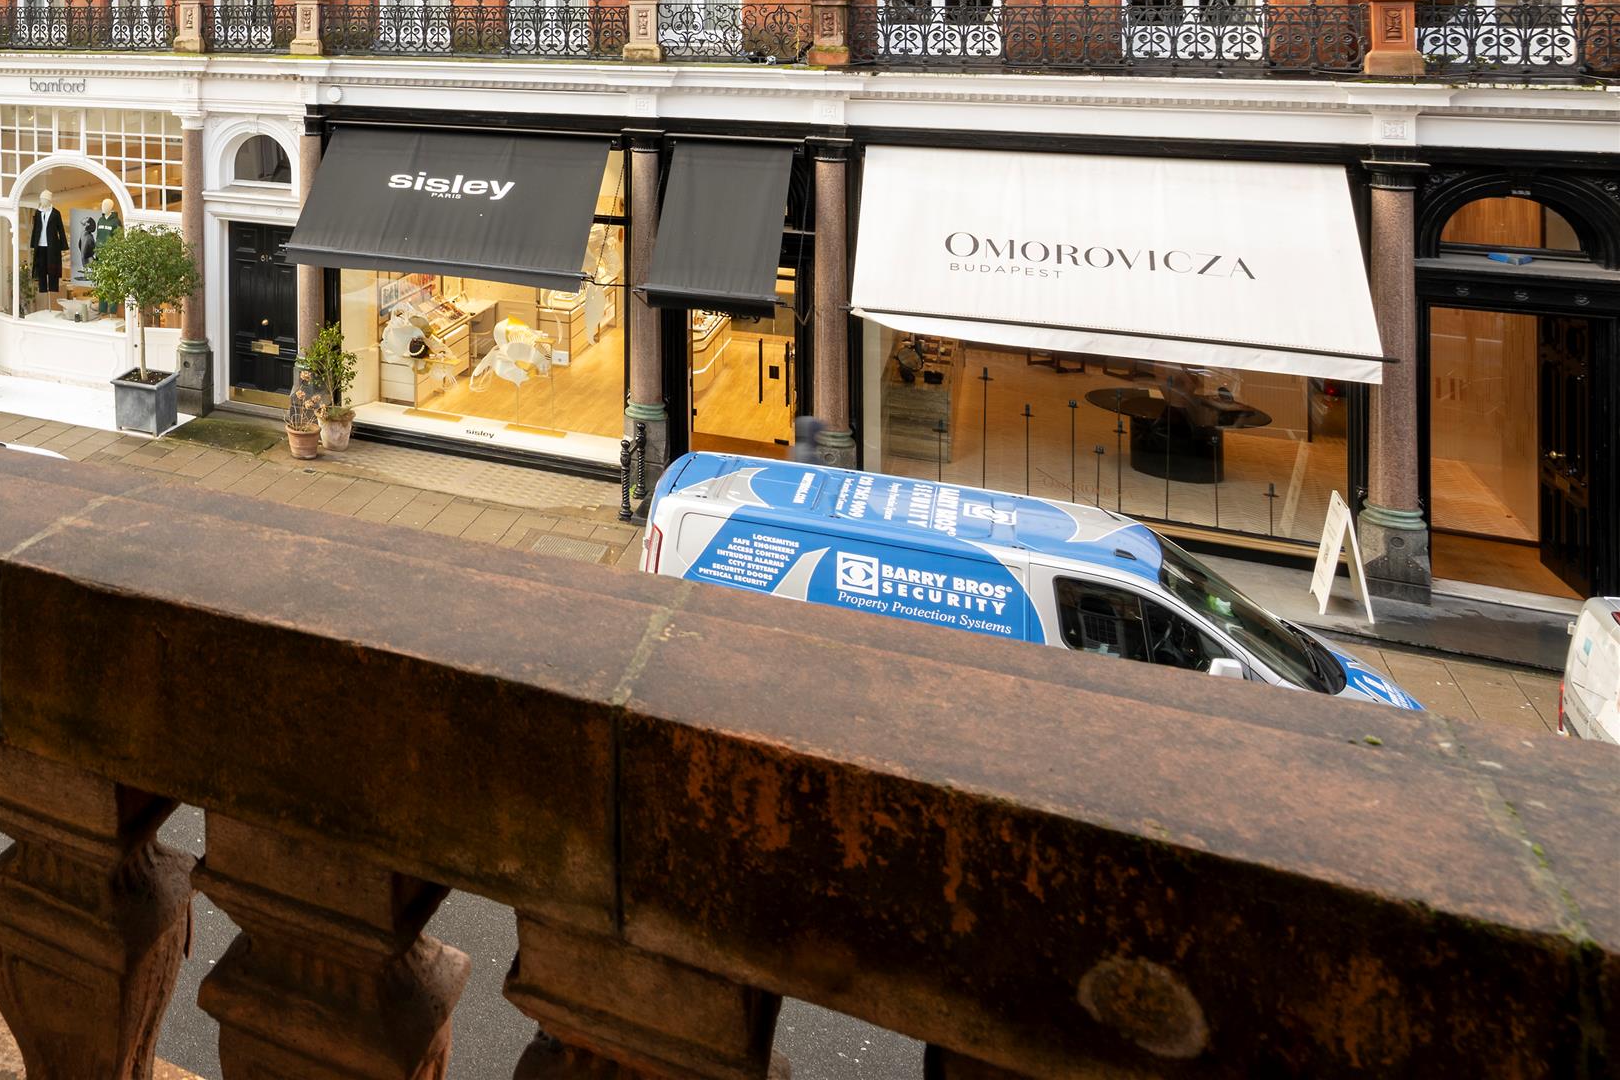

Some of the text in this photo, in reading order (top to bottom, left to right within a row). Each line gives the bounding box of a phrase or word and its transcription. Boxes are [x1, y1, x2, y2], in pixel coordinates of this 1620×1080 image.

[30, 77, 86, 93] bamford
[388, 171, 516, 201] sisley
[431, 192, 462, 200] PARIS
[945, 231, 1256, 280] OMOROVICZA
[950, 262, 1063, 279] BUDAPEST
[907, 483, 933, 528] SECURITY
[733, 537, 795, 555] SAFE ENGINEERS
[752, 533, 800, 548] LOCKSMITHS
[716, 549, 785, 568] INTRUDER ALARMS
[727, 544, 790, 562] ACCESS CONTROL
[712, 563, 773, 581] SECURITY DOORS
[728, 559, 779, 574] CCTV SYSTEMS
[698, 567, 768, 587] PHYSICAL SECURITY
[882, 564, 947, 588] BARRY
[882, 581, 1006, 615] SECURITY
[838, 590, 1012, 635] Property Protection Systems
